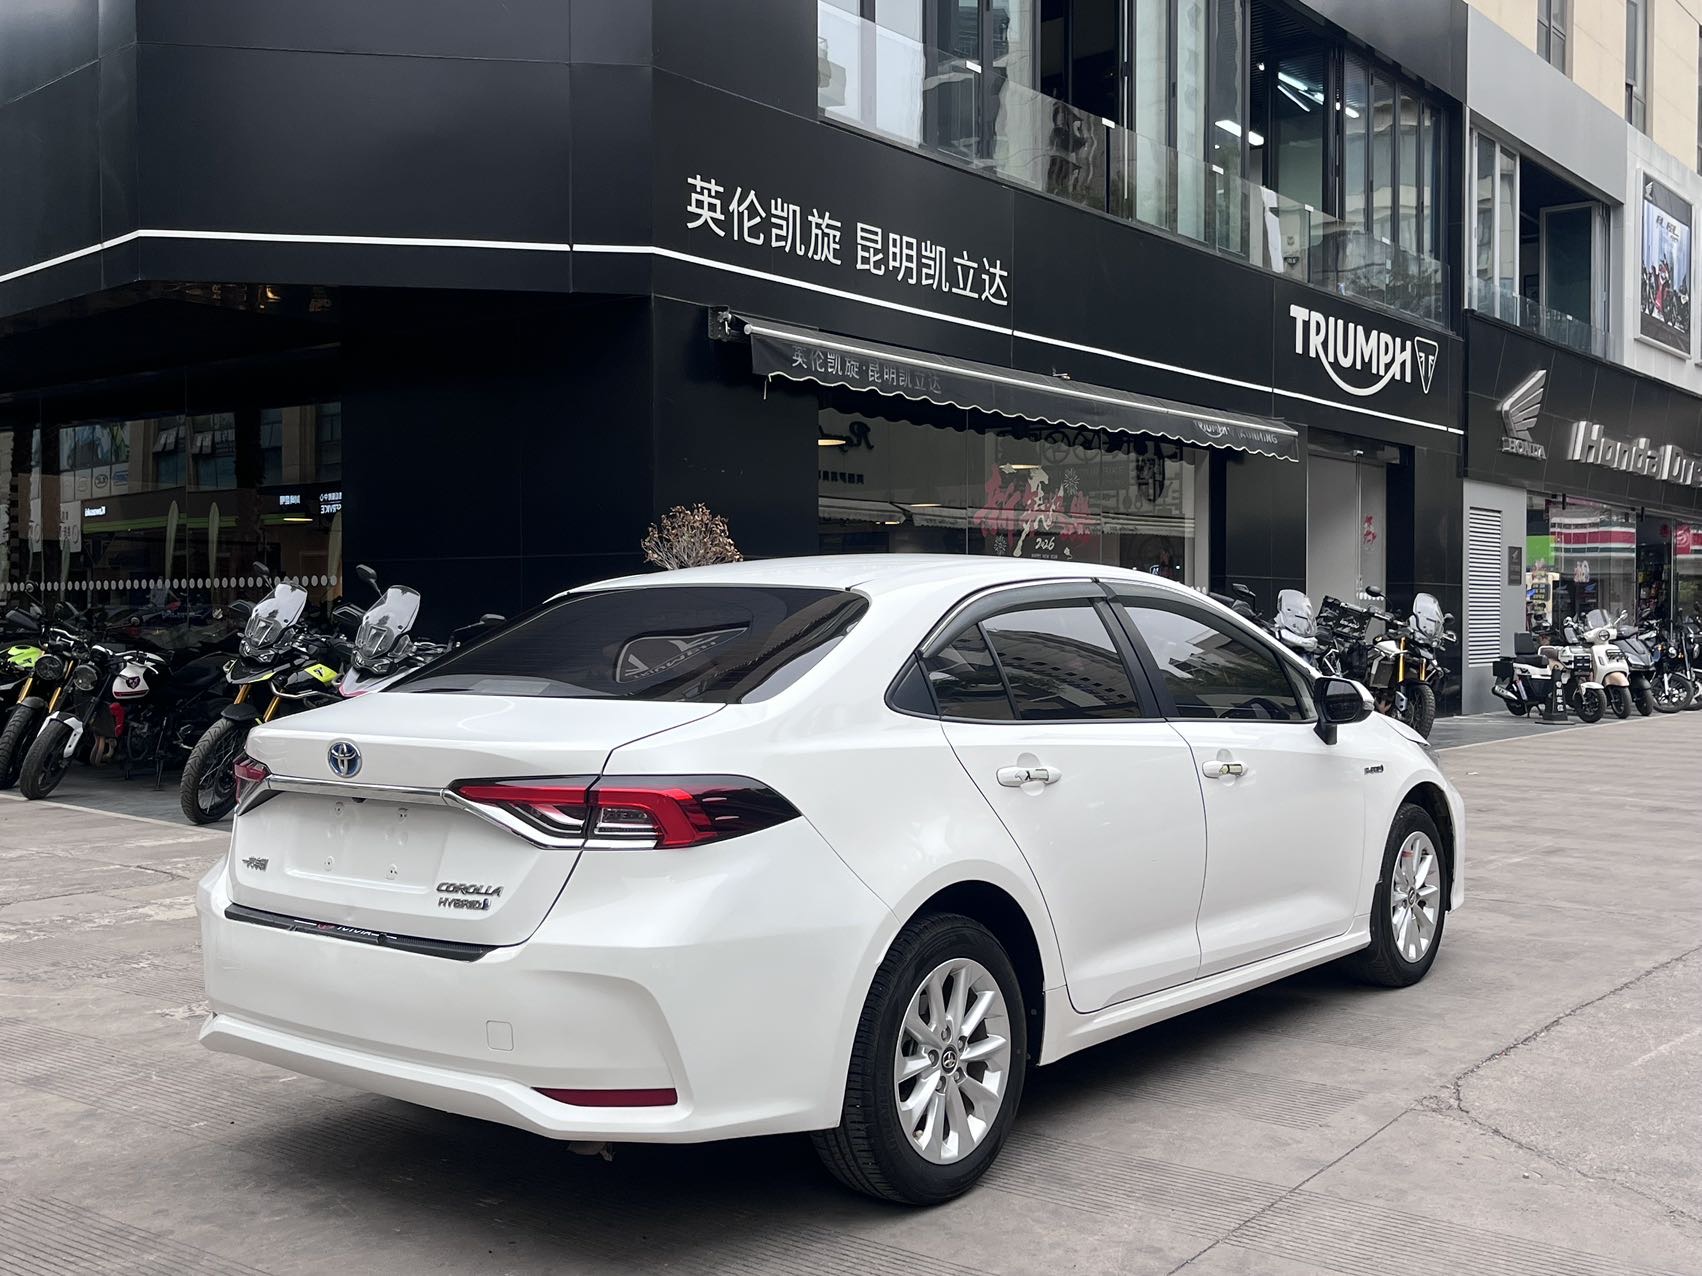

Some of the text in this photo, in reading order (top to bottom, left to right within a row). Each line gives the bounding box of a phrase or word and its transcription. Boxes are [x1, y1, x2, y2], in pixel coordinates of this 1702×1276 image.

[687, 174, 1009, 306] 英伦凯旋 昆明凯立达
[1289, 303, 1412, 396] TRIUMPH
[436, 882, 504, 898] COROLLA
[438, 897, 482, 911] HYBRID
